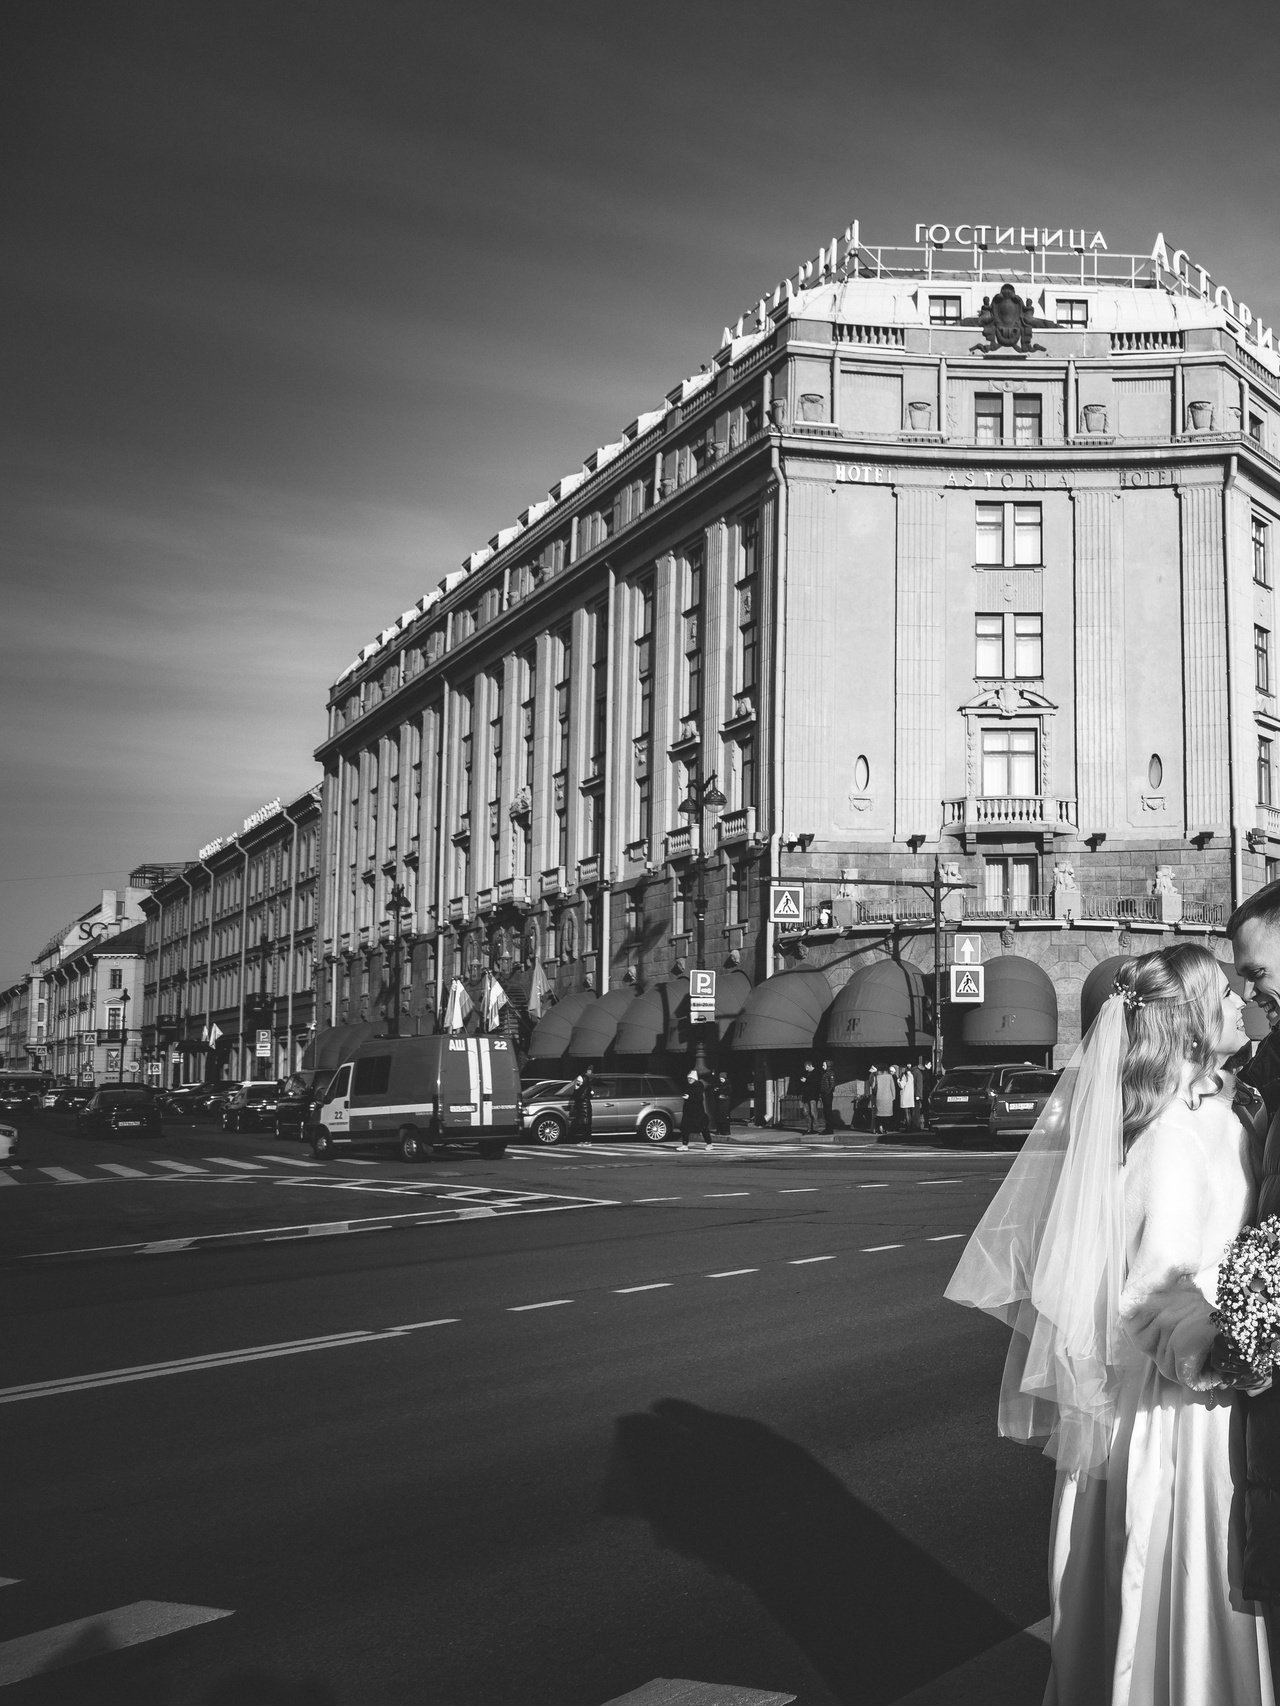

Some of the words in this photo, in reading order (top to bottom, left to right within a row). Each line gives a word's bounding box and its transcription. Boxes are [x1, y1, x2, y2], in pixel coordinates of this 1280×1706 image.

[915, 223, 1108, 250] ГОСТИНИЦА
[835, 464, 894, 483] HOTEL
[946, 471, 1070, 489] ASTORIA
[1119, 470, 1178, 488] HOTEL
[449, 1039, 466, 1051] АШ
[494, 1040, 508, 1050] 22
[334, 1110, 343, 1120] 22
